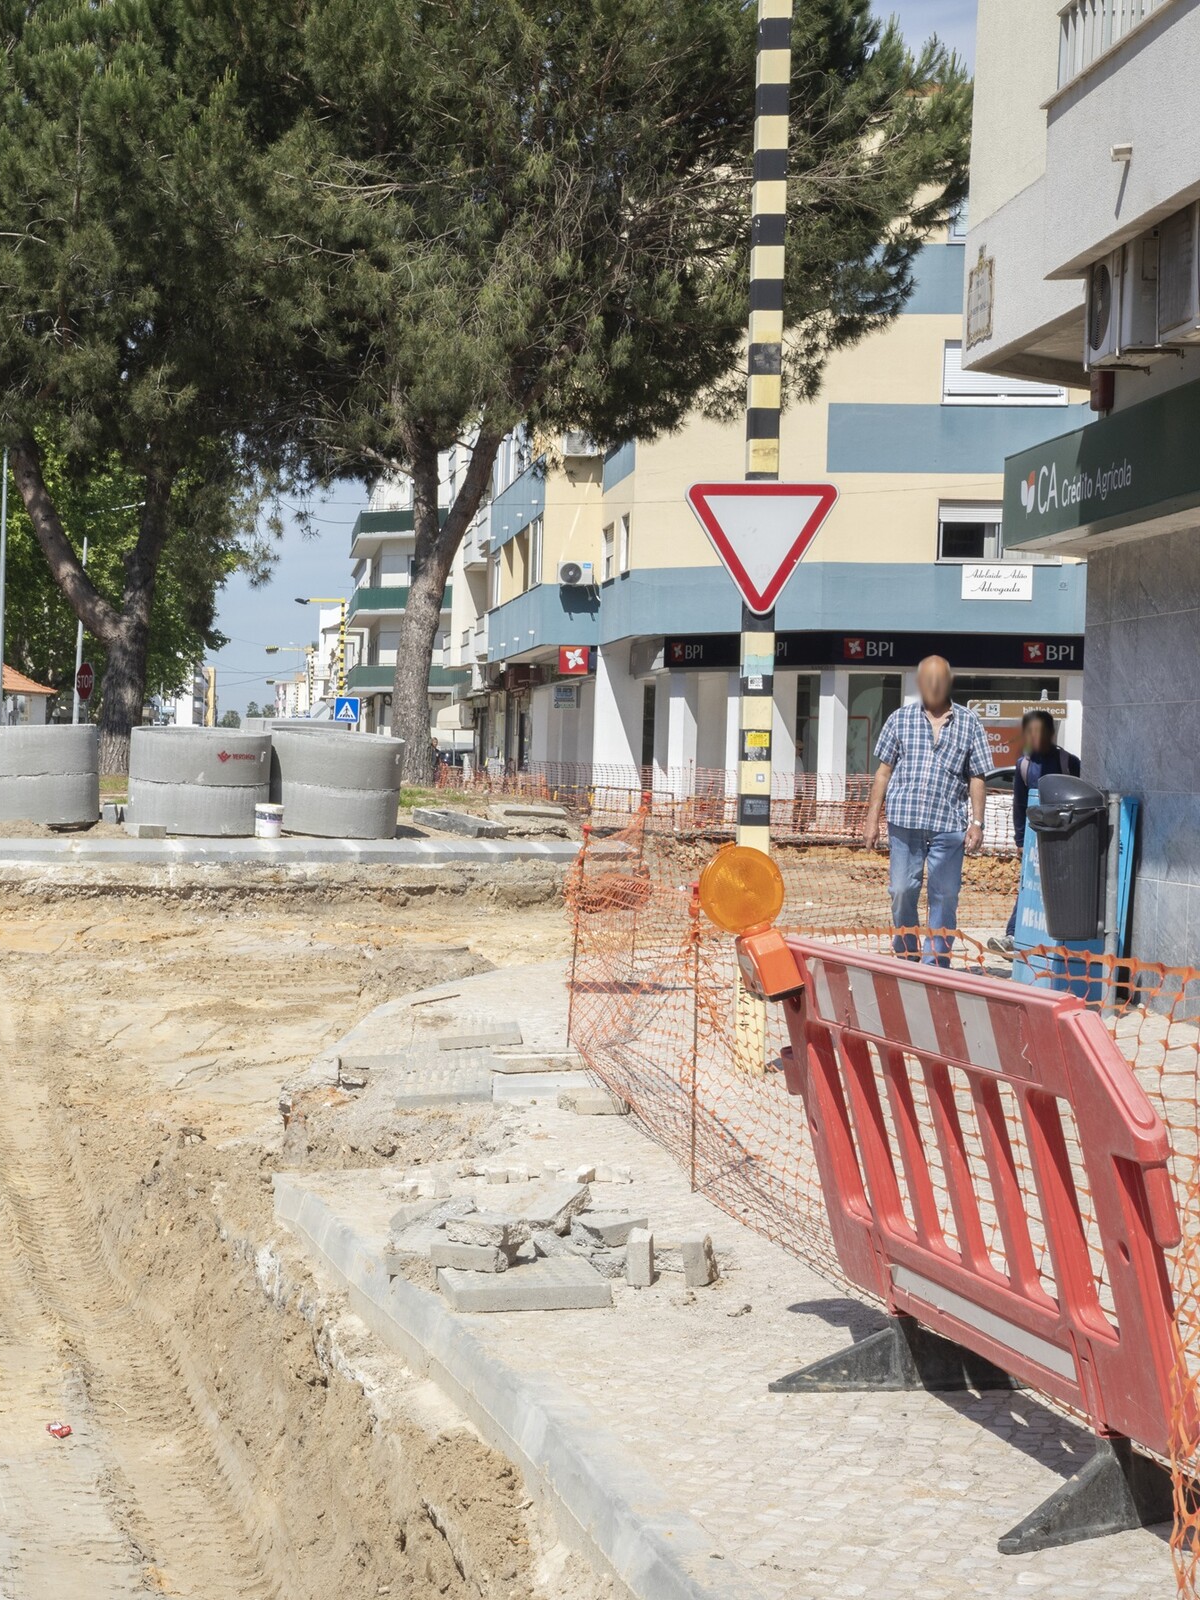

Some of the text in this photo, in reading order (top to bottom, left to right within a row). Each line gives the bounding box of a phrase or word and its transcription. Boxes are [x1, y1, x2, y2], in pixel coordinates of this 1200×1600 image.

[1037, 457, 1132, 515] CA Crédito Agrícola
[970, 580, 1021, 595] Advogada
[684, 644, 704, 660] BPI
[776, 641, 788, 657] PI
[865, 641, 894, 658] BPI
[1045, 644, 1074, 661] BPI
[77, 674, 93, 689] STOP
[990, 743, 1010, 753] ado
